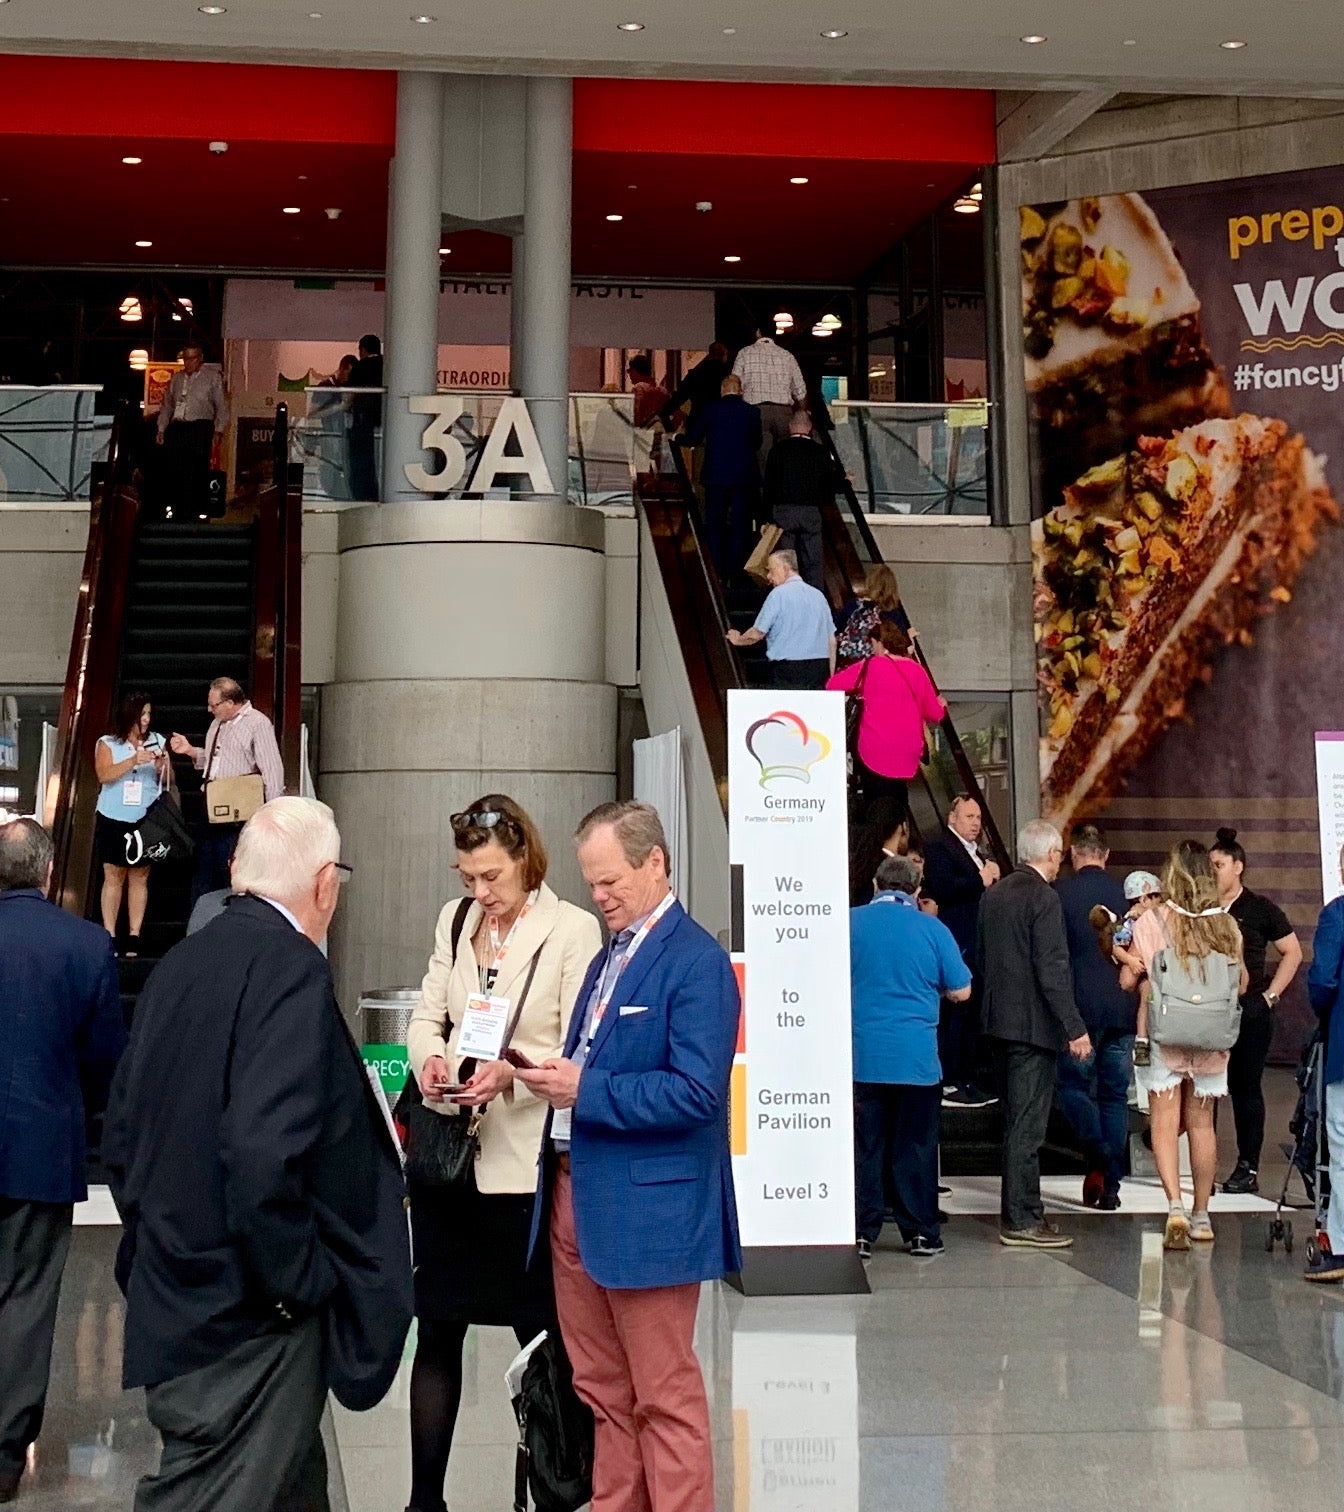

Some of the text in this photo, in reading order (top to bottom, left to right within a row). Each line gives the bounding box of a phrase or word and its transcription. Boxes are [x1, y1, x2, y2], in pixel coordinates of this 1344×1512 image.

[403, 395, 555, 495] 3A
[764, 795, 825, 813] Germany
[774, 876, 803, 893] We
[752, 900, 832, 916] welcome
[775, 927, 809, 943] you
[782, 989, 799, 1004] to
[777, 1012, 805, 1028] the
[757, 1089, 831, 1106] German
[757, 1113, 832, 1130] Pavilion
[763, 1182, 829, 1201] Level 3
